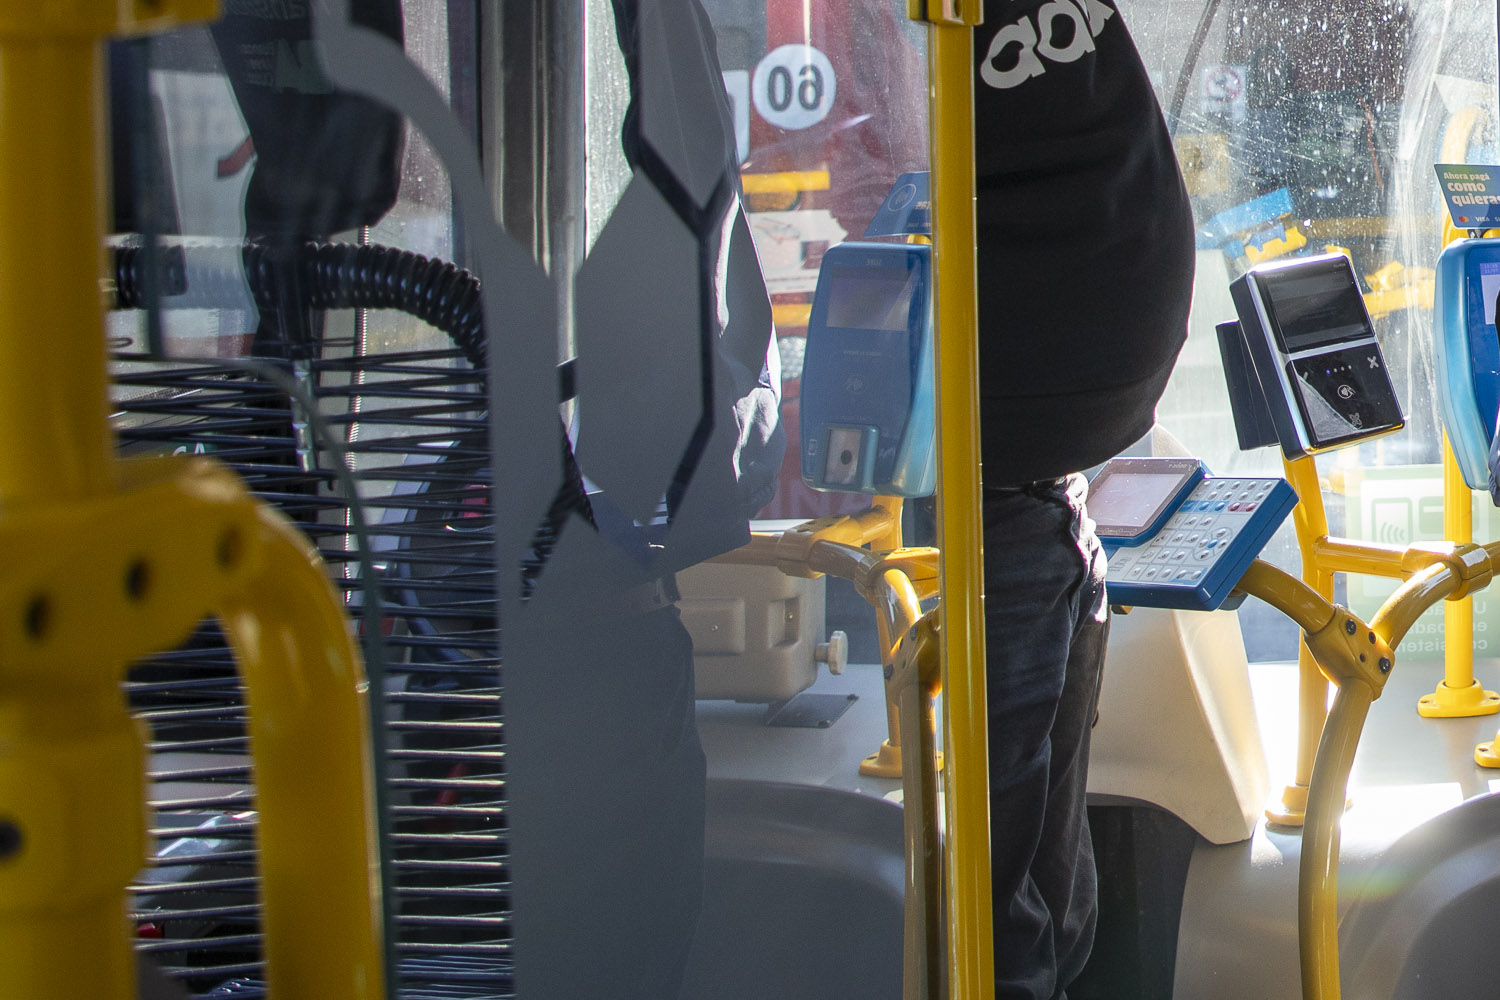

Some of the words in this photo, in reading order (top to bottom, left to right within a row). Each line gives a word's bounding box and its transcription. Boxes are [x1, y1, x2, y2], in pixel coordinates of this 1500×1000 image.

[1443, 172, 1469, 180] Ahora
[1470, 172, 1491, 181] pagá
[1447, 182, 1486, 192] como
